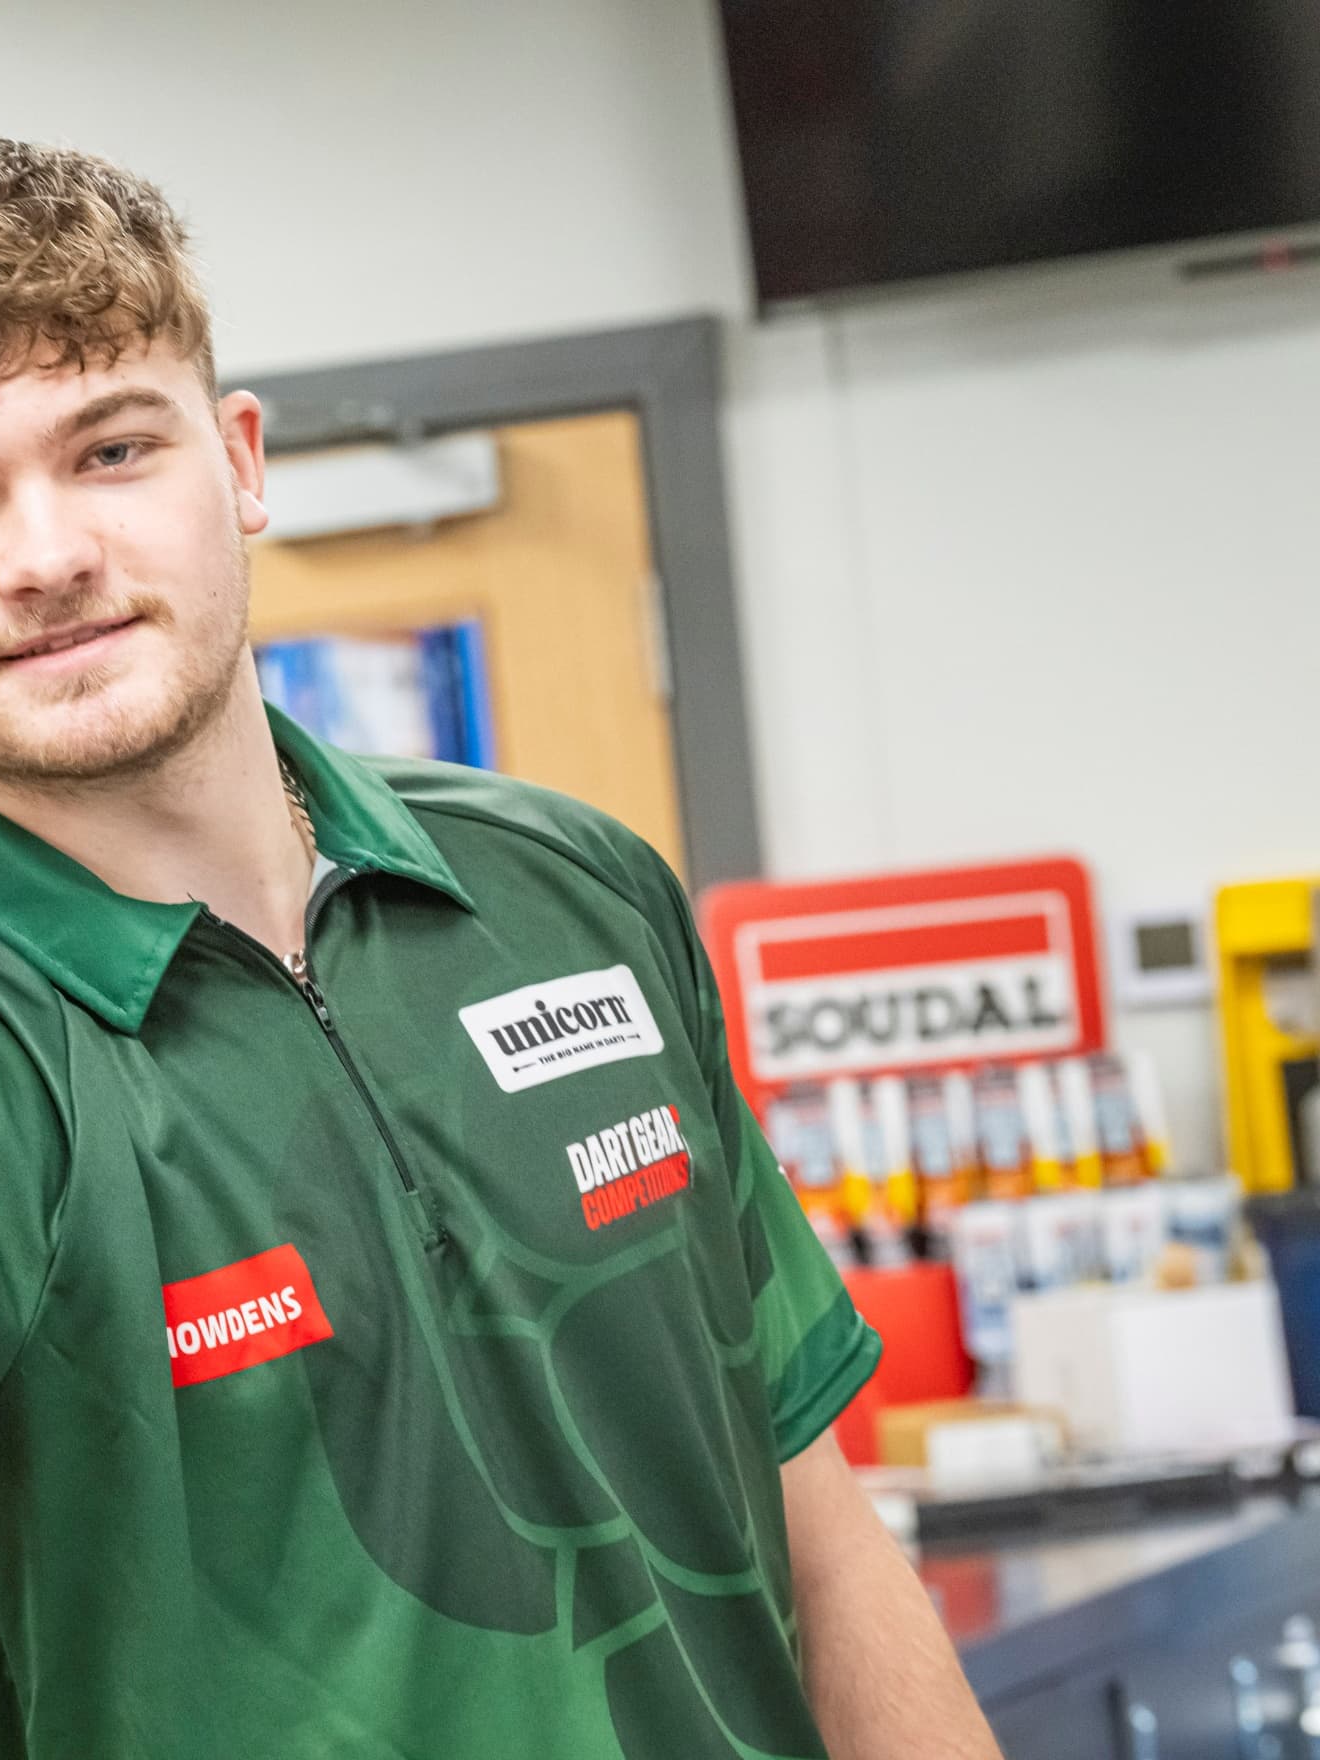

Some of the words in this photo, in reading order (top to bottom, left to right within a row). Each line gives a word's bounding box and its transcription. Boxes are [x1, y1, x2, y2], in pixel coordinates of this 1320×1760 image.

[488, 995, 633, 1056] unicorn
[765, 974, 1063, 1058] SOUDAL
[538, 1054, 557, 1065] THE
[556, 1047, 573, 1059] BIG
[573, 1041, 596, 1054] NAME
[566, 1121, 638, 1194] DART
